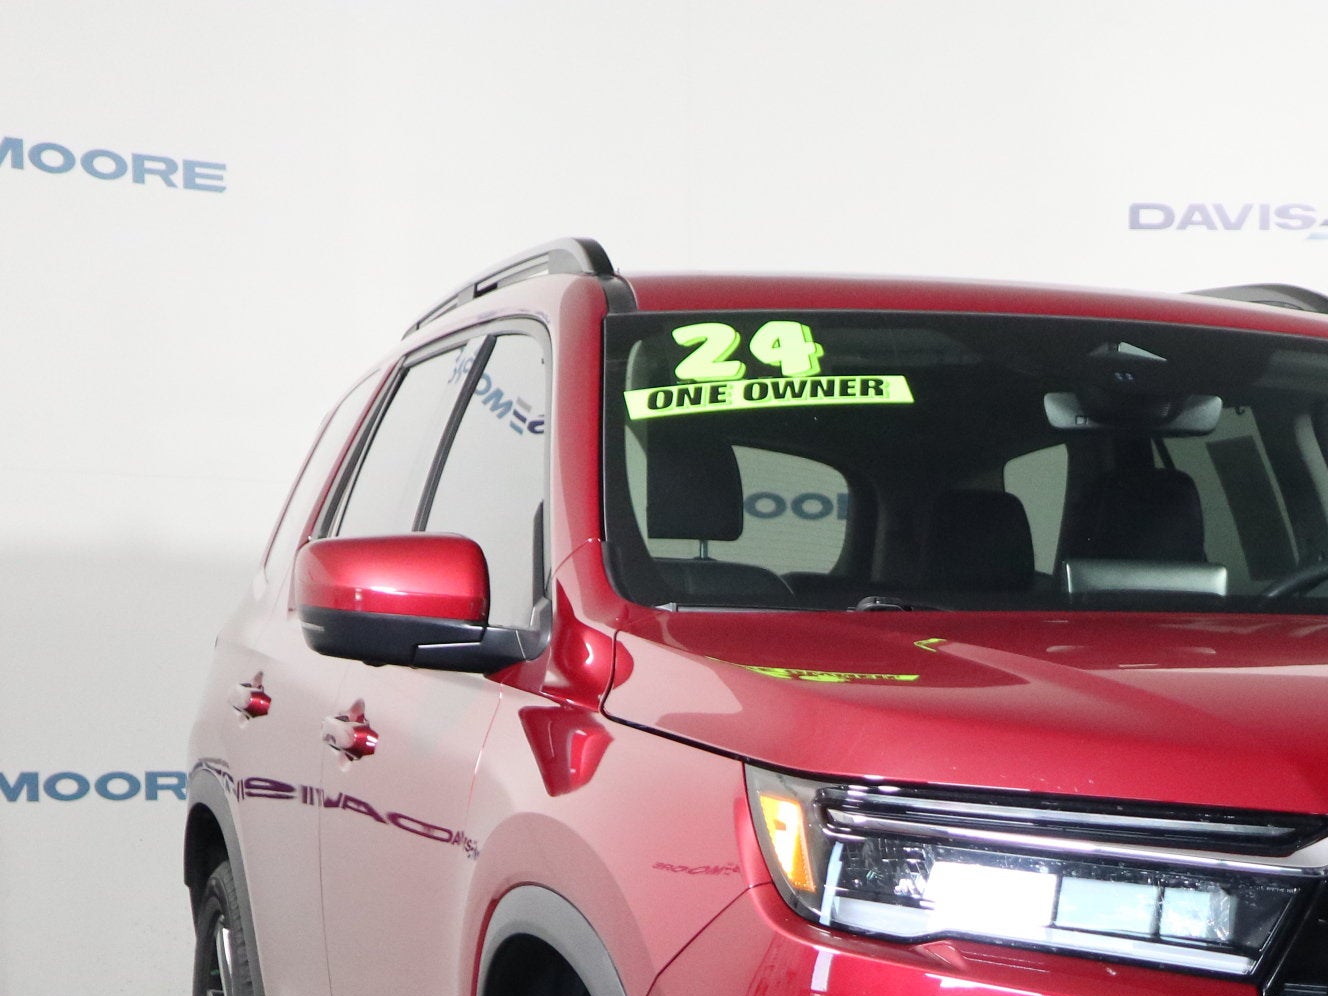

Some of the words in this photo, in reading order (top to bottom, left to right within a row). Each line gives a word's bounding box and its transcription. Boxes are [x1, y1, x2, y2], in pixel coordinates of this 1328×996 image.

[671, 320, 824, 382] 24
[646, 383, 729, 411] ONE
[742, 377, 885, 402] OWNER
